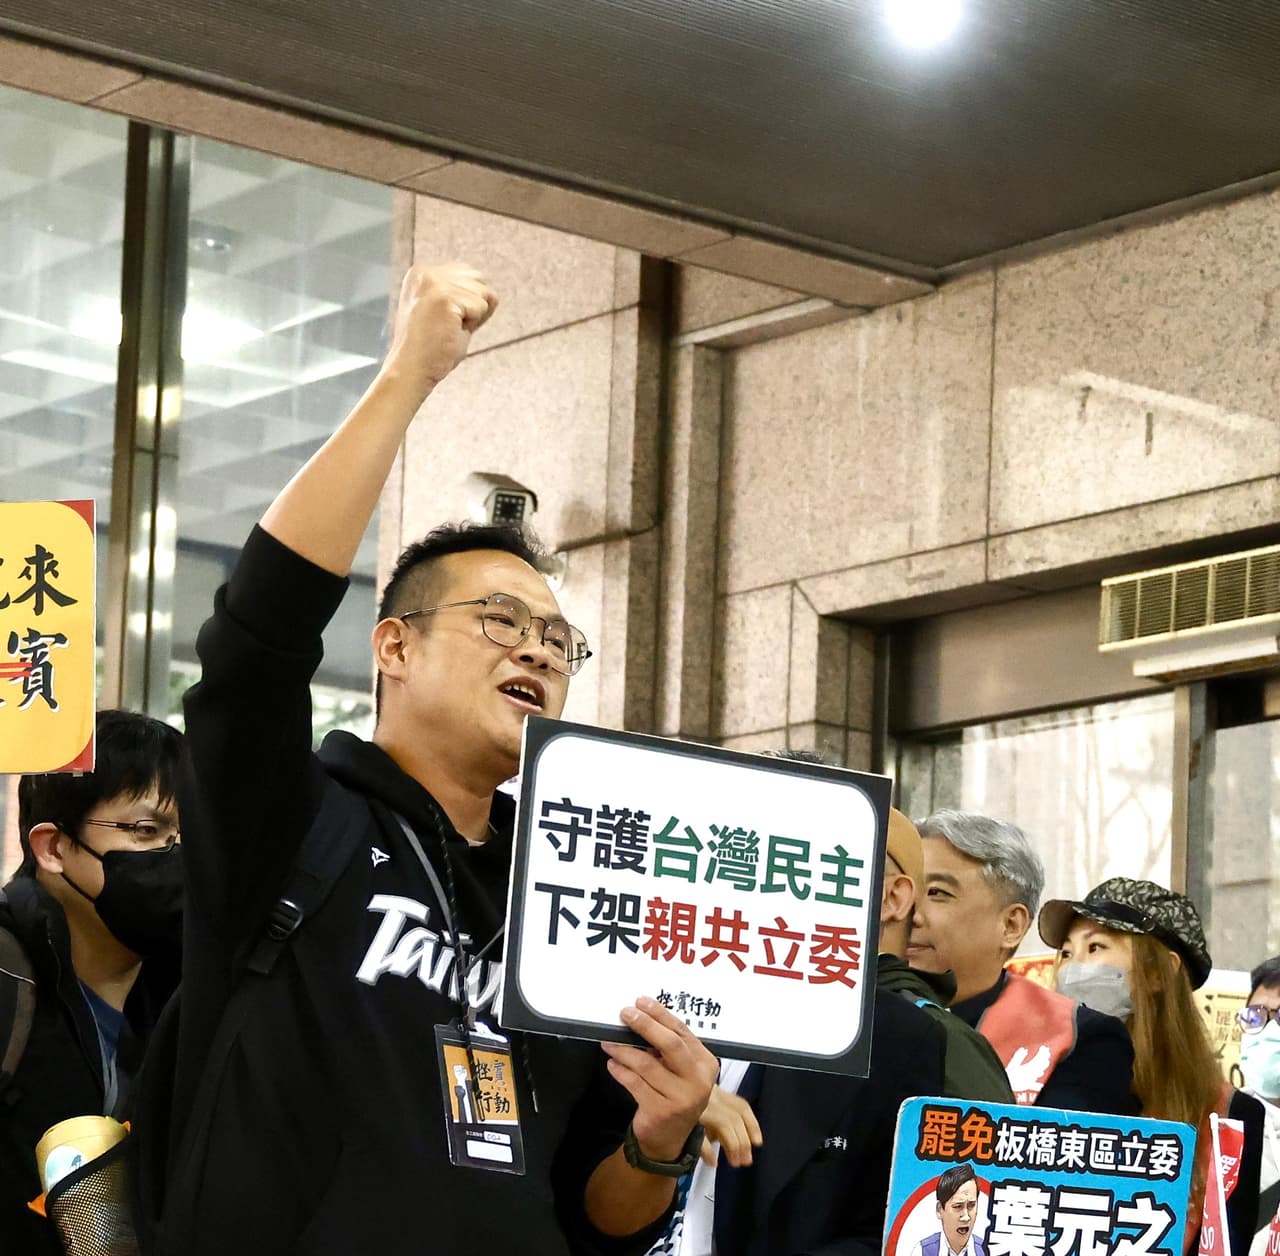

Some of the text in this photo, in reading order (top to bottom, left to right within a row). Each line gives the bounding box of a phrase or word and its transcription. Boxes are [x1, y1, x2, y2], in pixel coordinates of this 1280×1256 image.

[537, 796, 865, 908] 守護台灣民主
[532, 881, 861, 989] 下架親共立委
[918, 1109, 1180, 1178] 罷免板橋東區立委
